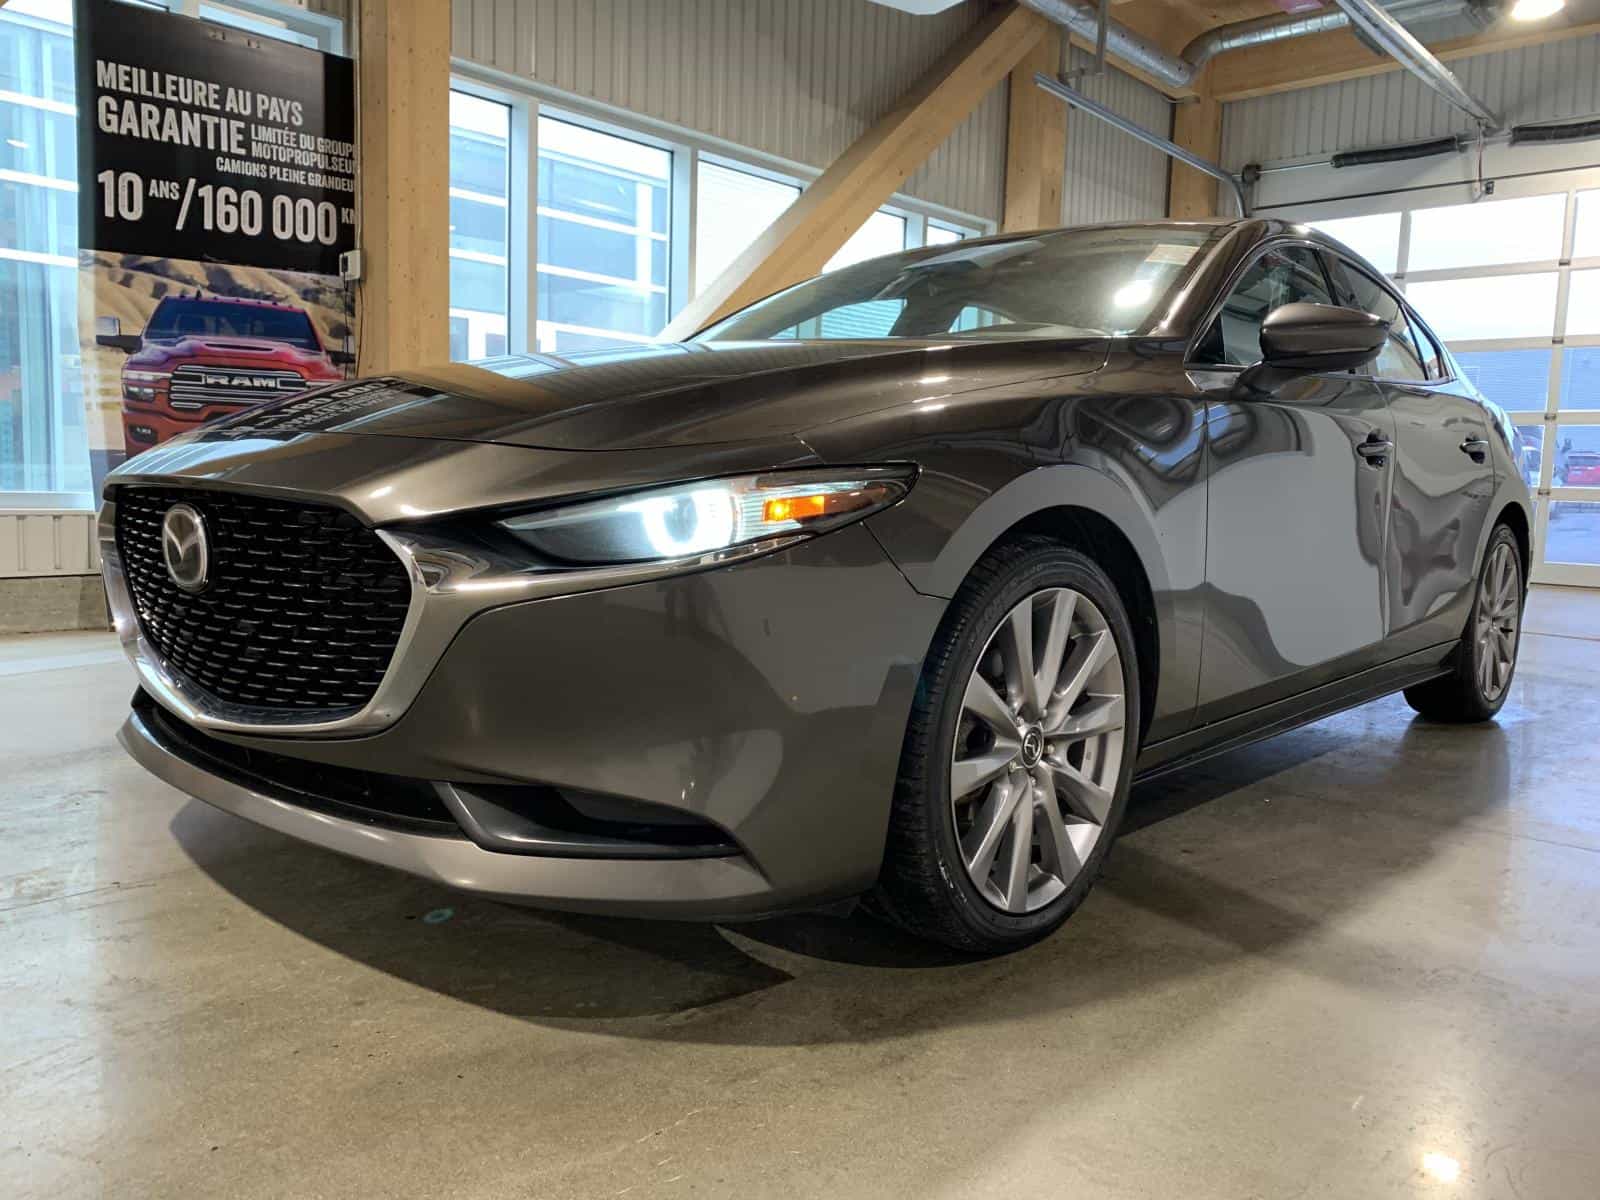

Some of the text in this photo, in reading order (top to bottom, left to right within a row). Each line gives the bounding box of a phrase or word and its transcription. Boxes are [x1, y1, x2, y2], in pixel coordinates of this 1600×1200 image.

[96, 59, 303, 126] MEILLEURE AU PAYS
[97, 95, 246, 155] GARANTIE
[251, 123, 297, 148] LIMITÉE
[299, 133, 315, 151] DU
[216, 156, 267, 179] CAMIONS
[269, 165, 307, 184] PLEINE
[98, 169, 143, 221] 10
[148, 179, 180, 201] ANS
[272, 194, 337, 245] 000
[206, 375, 276, 389] RAM
